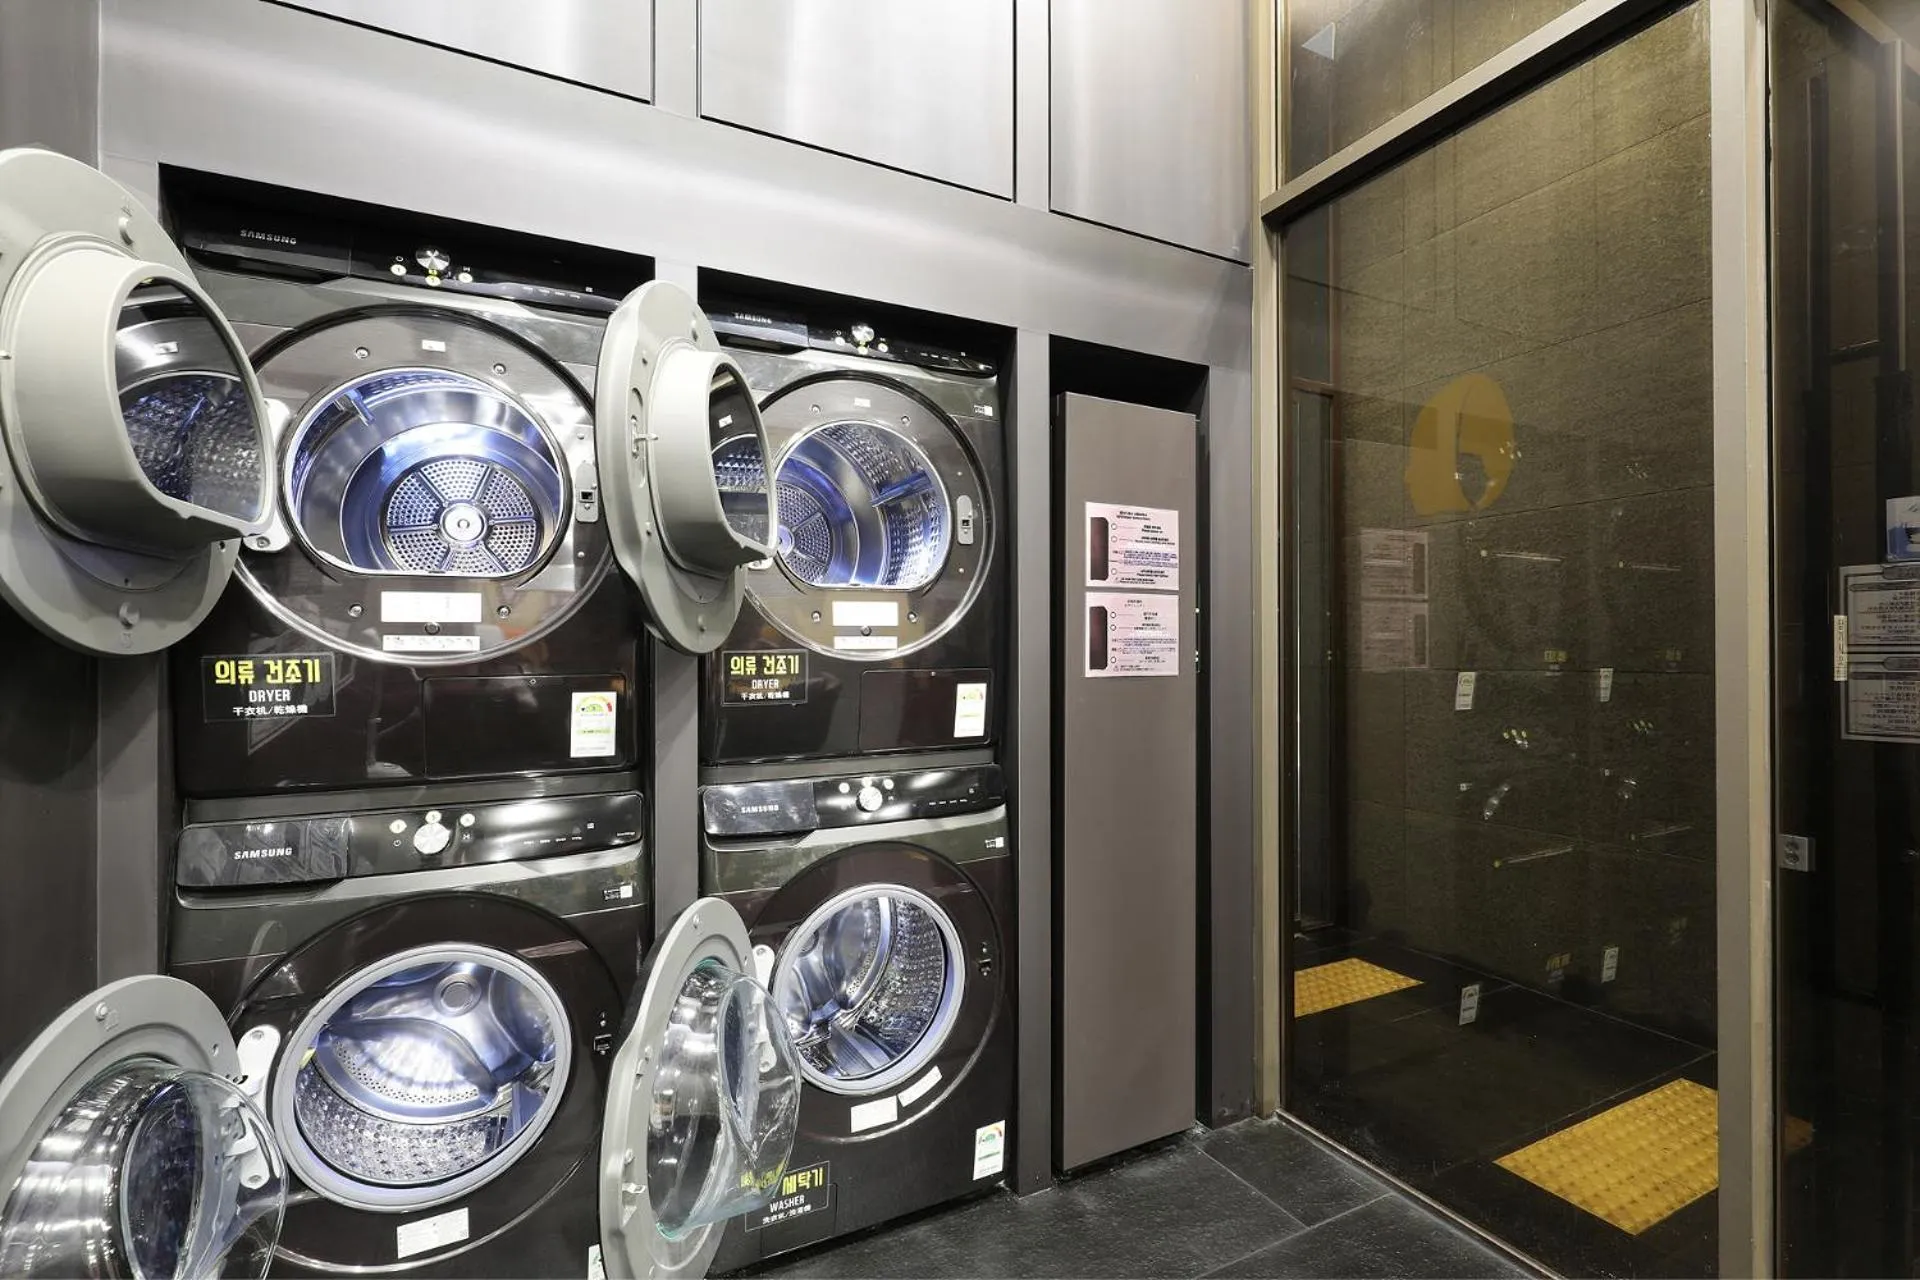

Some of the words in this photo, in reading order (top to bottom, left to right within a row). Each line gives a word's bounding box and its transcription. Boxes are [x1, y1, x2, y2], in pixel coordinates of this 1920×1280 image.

[240, 229, 297, 245] SAMSUNG
[214, 660, 255, 685] 의류
[263, 659, 320, 684] 건조기
[730, 655, 757, 675] 의류
[762, 654, 799, 675] 건조기
[751, 679, 780, 690] DRYER
[248, 689, 291, 703] DRYER
[233, 847, 293, 860] SAMSUNG
[782, 1167, 823, 1196] 세탁기
[769, 1194, 805, 1213] WASHER
